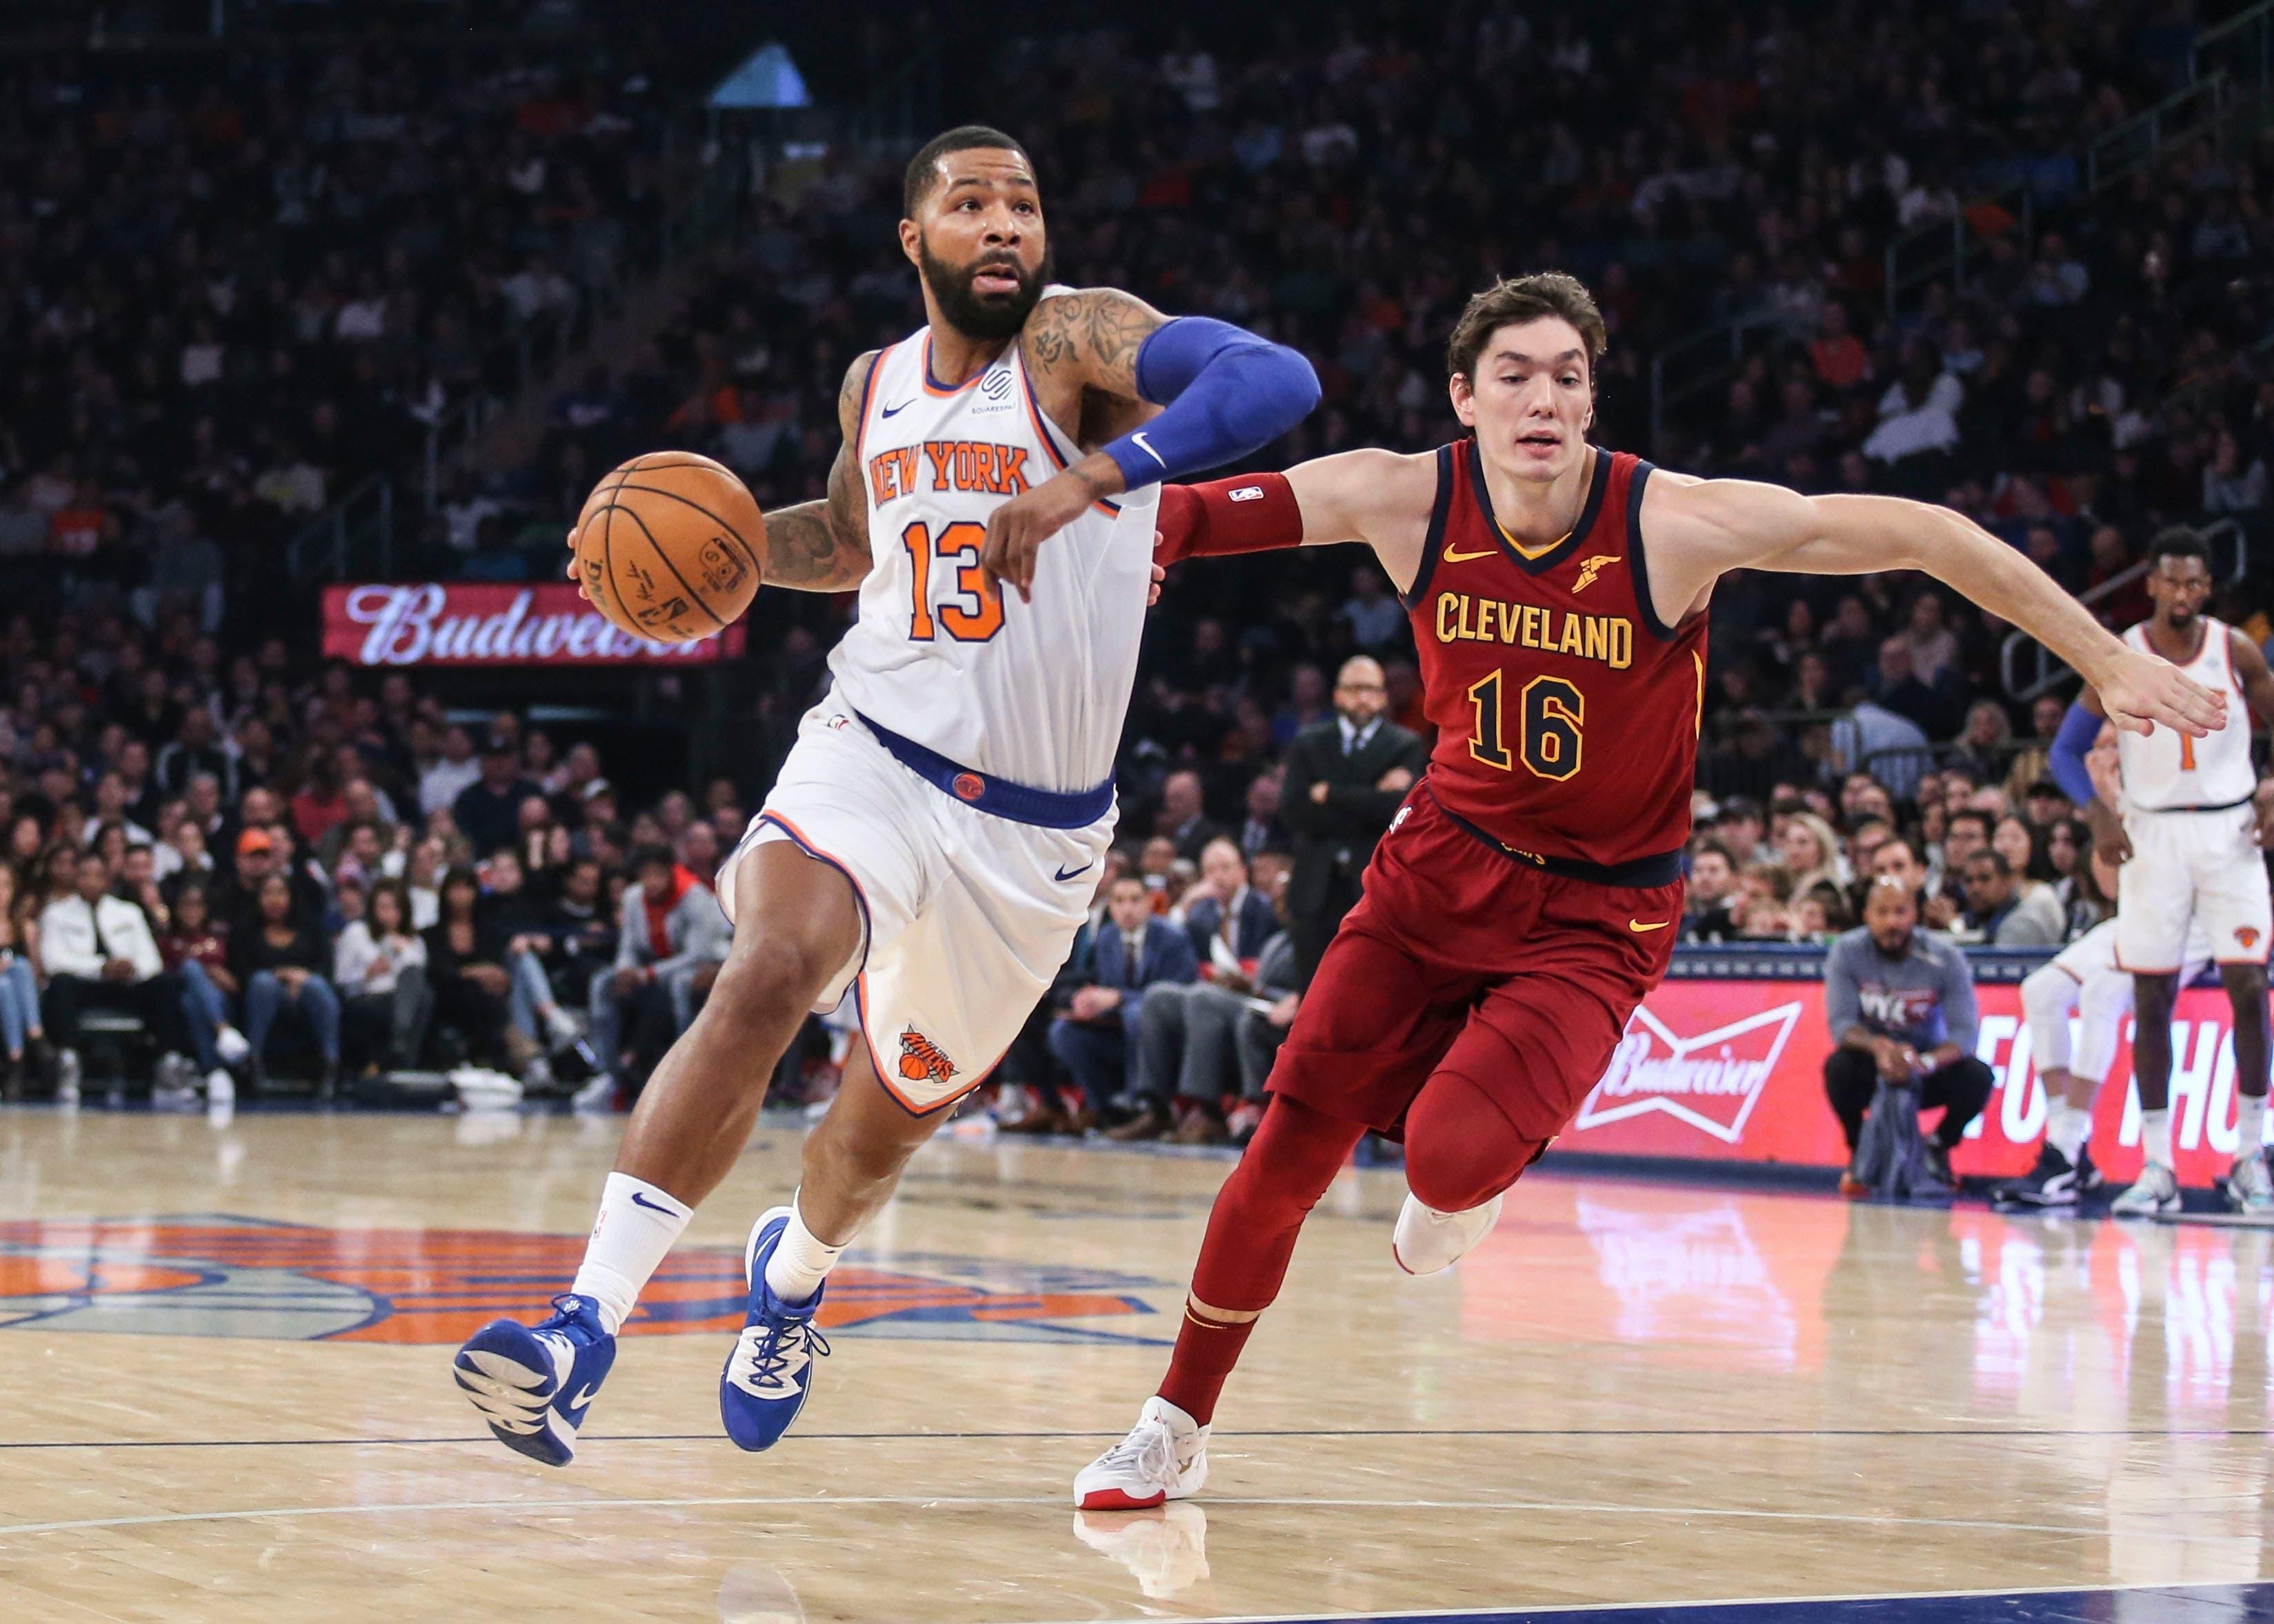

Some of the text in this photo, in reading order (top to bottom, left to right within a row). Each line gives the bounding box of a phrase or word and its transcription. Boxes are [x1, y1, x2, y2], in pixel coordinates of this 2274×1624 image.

[868, 440, 1033, 512] NEW YORK
[901, 521, 1006, 643] 13
[346, 583, 721, 666] Budwei
[1435, 590, 1634, 670] CLEVELAND
[1466, 667, 1585, 782] 16
[900, 1032, 955, 1082] KNICKS
